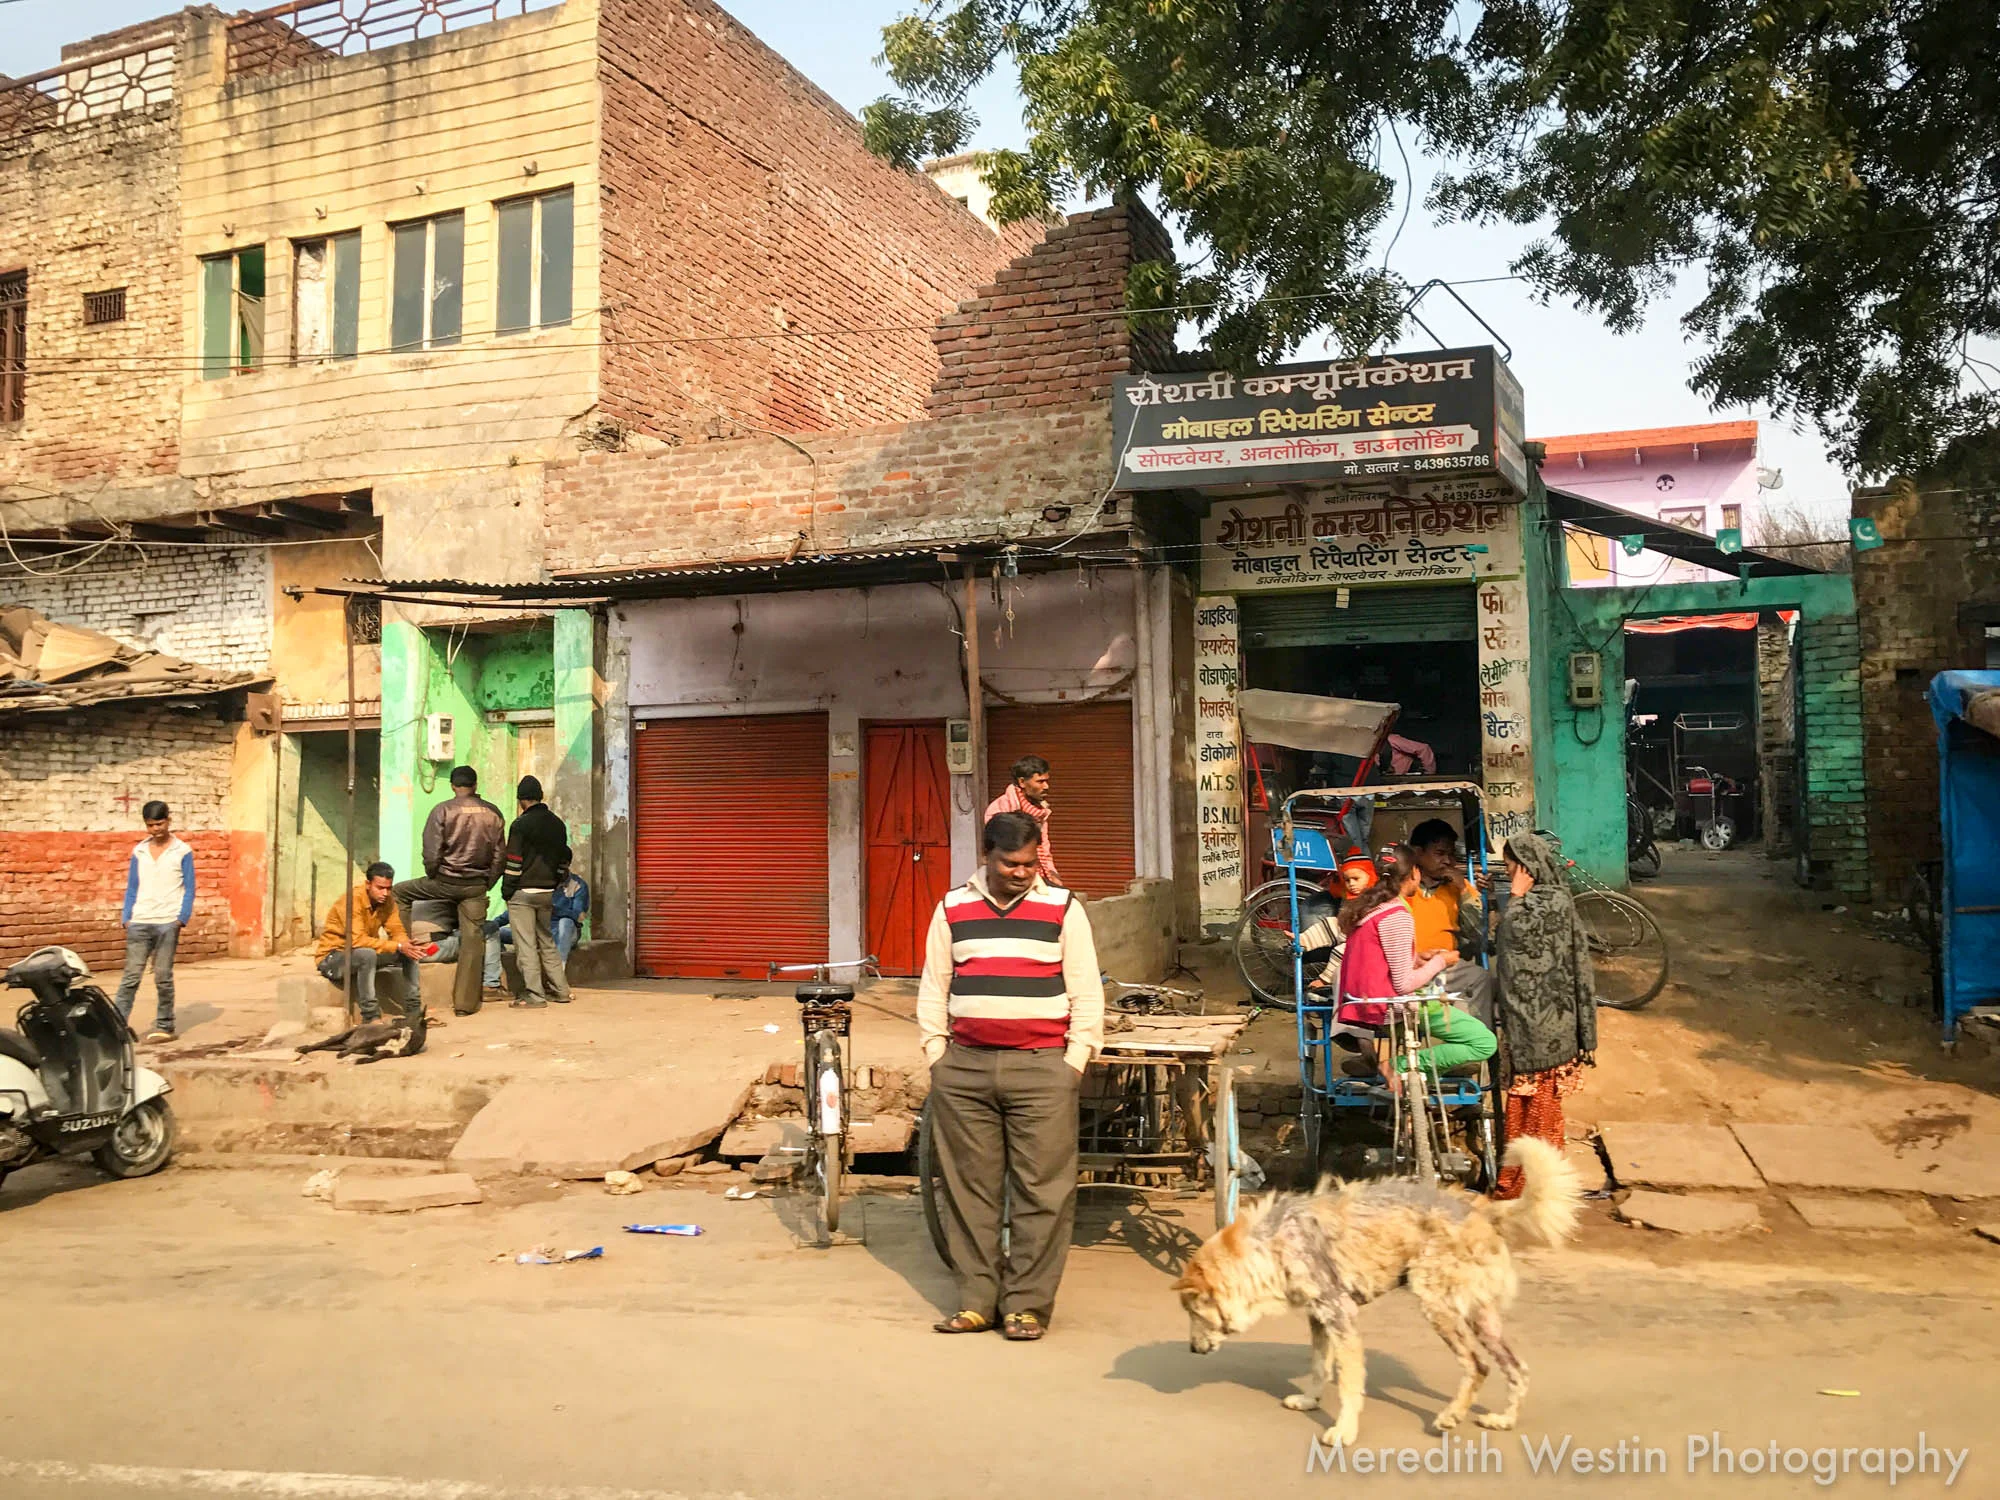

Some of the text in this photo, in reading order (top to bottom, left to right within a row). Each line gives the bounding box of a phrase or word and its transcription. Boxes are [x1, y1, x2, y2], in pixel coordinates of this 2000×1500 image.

[1125, 371, 1236, 406] रोशनी
[1242, 357, 1475, 401] कम्यूनिकेशन
[1161, 400, 1437, 440] मोबाइल रिपेयरिंग सेन्टर
[1137, 430, 1464, 468] सोफ्टवेयर, अनलोकिंग, डाउनलोडिंग
[1344, 462, 1361, 475] मो.
[1364, 461, 1400, 474] सत्तार
[1414, 454, 1489, 471] 8439635786
[1216, 503, 1308, 551] रोशनी
[1232, 551, 1301, 575] मोबाइल
[1310, 542, 1400, 571] रिपेयरिंग
[1198, 605, 1238, 627] आइडिया
[1199, 634, 1236, 656] एयरटेल
[1199, 663, 1237, 685] वोडाफोन
[1199, 696, 1235, 721] रिलाइंस
[1206, 731, 1223, 739] टाटा
[1200, 741, 1237, 762] डोकोमो
[1201, 827, 1238, 850] यूनीनोर
[60, 1115, 118, 1133] SUZUKI
